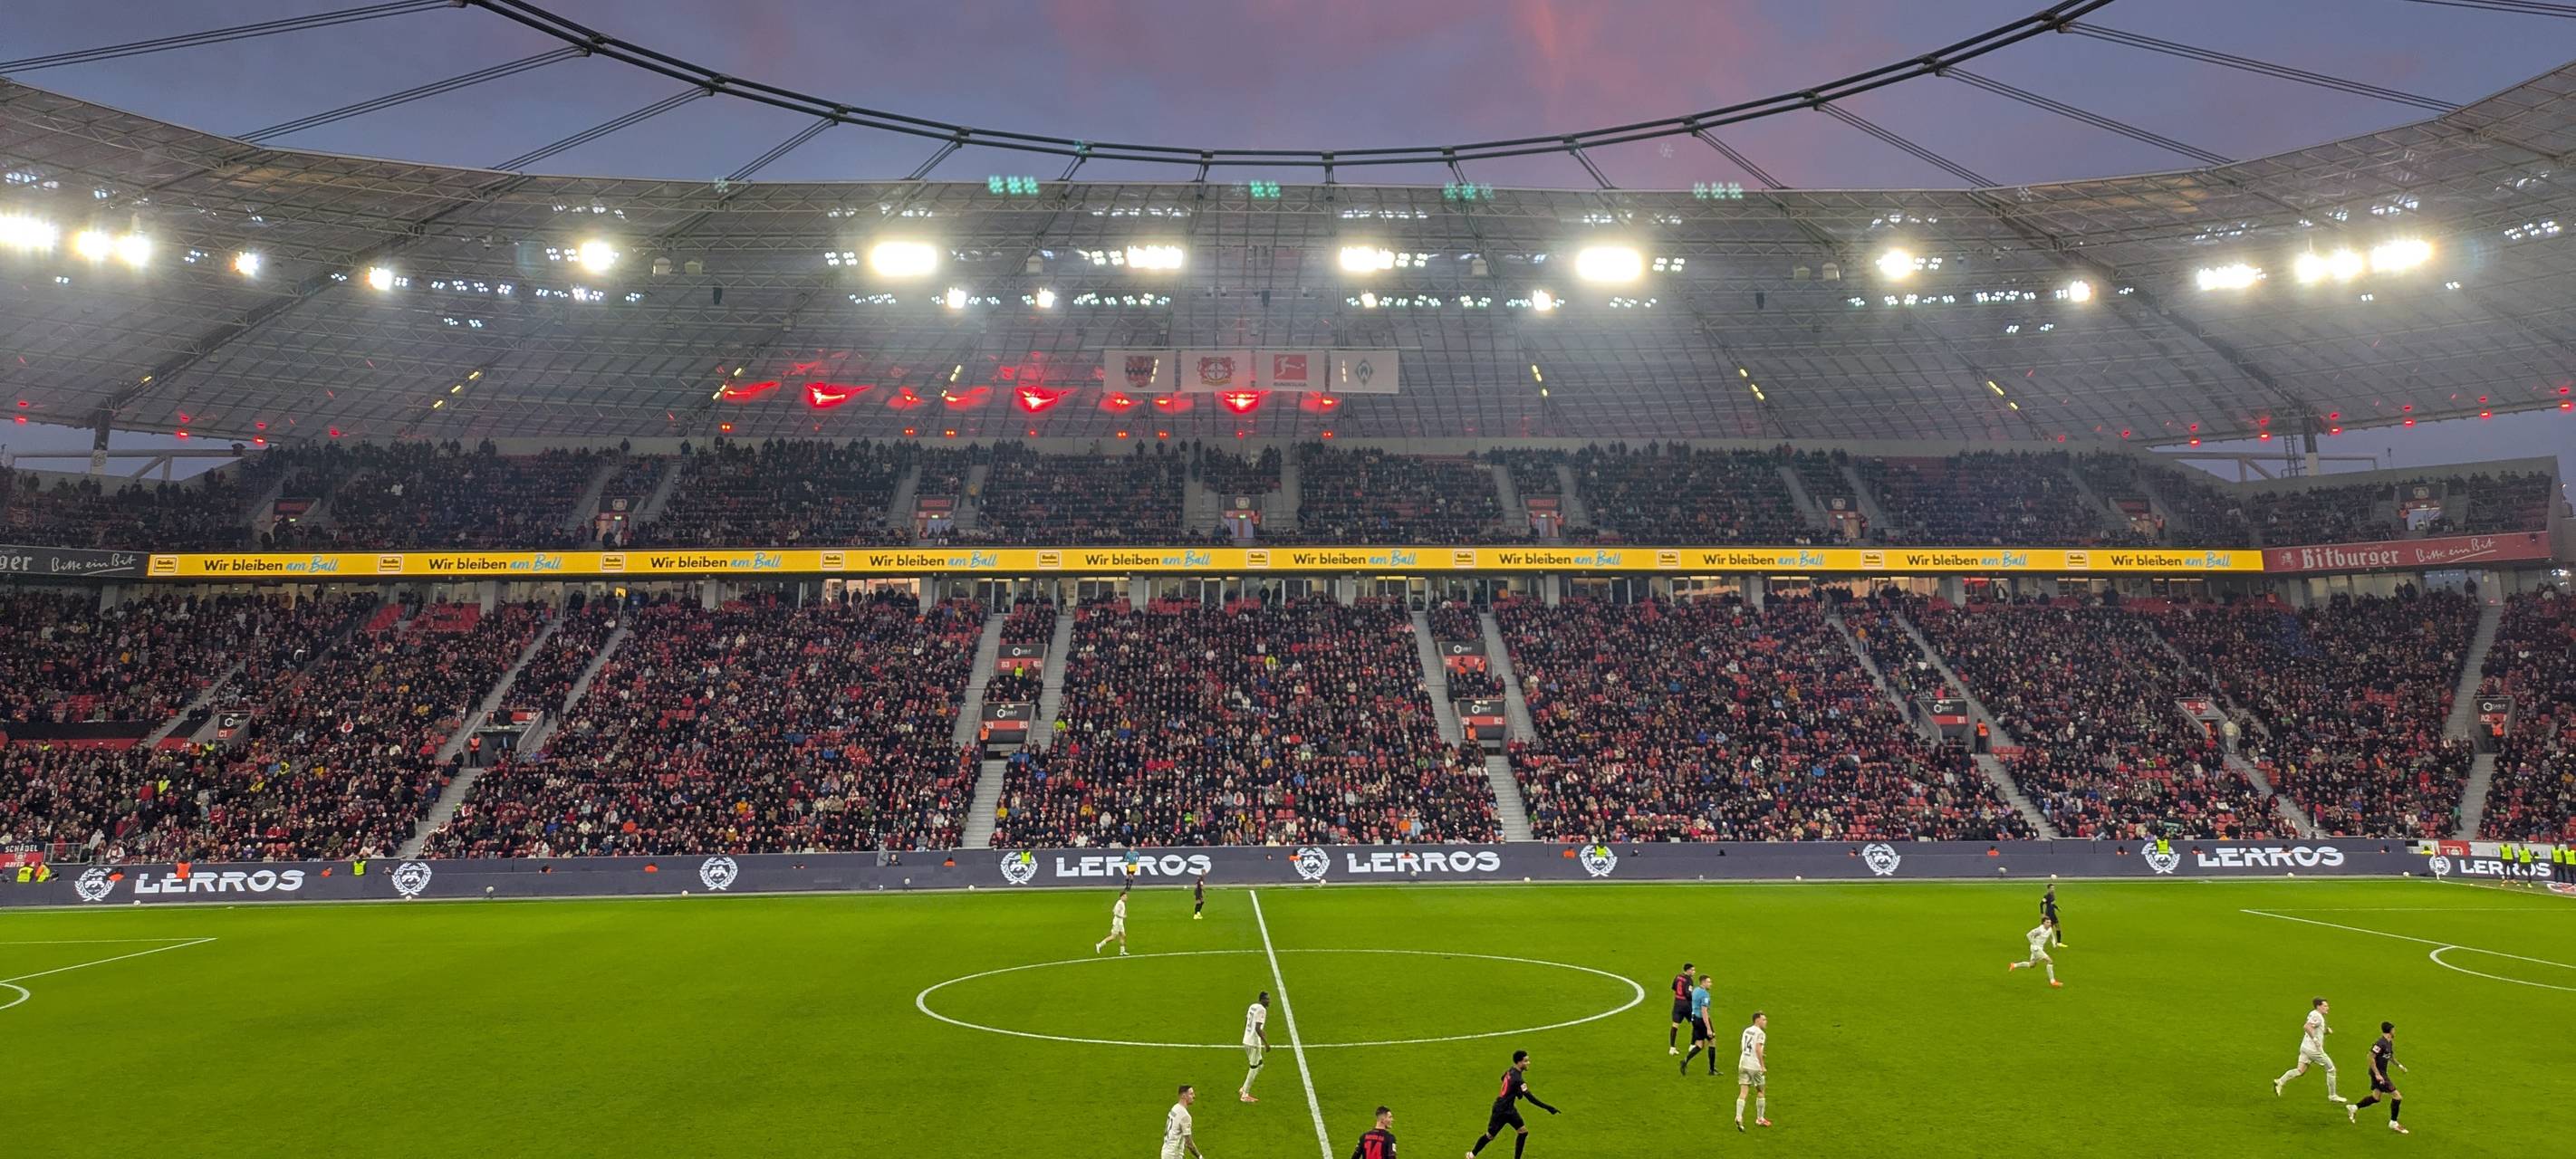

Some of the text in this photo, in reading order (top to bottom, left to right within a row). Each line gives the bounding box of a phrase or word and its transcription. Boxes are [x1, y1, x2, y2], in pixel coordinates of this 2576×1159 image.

[1085, 555, 1108, 564] Wir
[1112, 554, 1158, 564] bleiben
[1184, 550, 1210, 566] Ball
[1293, 553, 1315, 563] Wir
[1320, 553, 1365, 563] bleiben
[1390, 550, 1416, 565] Ball
[2415, 538, 2495, 562] Bitte ein Bit
[51, 553, 137, 571] Bitte ein Bit
[205, 556, 338, 572] Wir bleiben am Ball
[428, 554, 561, 570] Wir bleiben am Ball
[650, 557, 674, 567] Wir
[678, 556, 726, 567] bleiben
[754, 552, 781, 569] Ball
[870, 555, 893, 565] Wir
[897, 555, 944, 565] bleiben
[970, 551, 996, 567] Ball
[1499, 554, 1522, 563] Wir
[1525, 553, 1571, 563] bleiben
[1595, 551, 1620, 566] Ball
[1703, 555, 1725, 564] Wir
[1729, 554, 1773, 564] bleiben
[1799, 551, 1824, 566] Ball
[1907, 555, 1929, 565] Wir
[1933, 555, 1978, 565] bleiben
[2002, 551, 2027, 567] Ball
[2110, 555, 2132, 565] Wir
[2137, 555, 2181, 565] bleiben
[2206, 551, 2231, 568] Ball
[2302, 548, 2399, 569] Bitburger
[2480, 714, 2491, 723] A2
[218, 730, 228, 738] C1
[5, 843, 38, 853] SCHÄDEL
[1346, 851, 1501, 873] LERROS
[2197, 846, 2344, 867] LERROS
[1056, 854, 1212, 877] LERROS
[134, 869, 305, 894] LERROS
[1744, 1035, 1753, 1052] 14
[1364, 1140, 1383, 1159] 14
